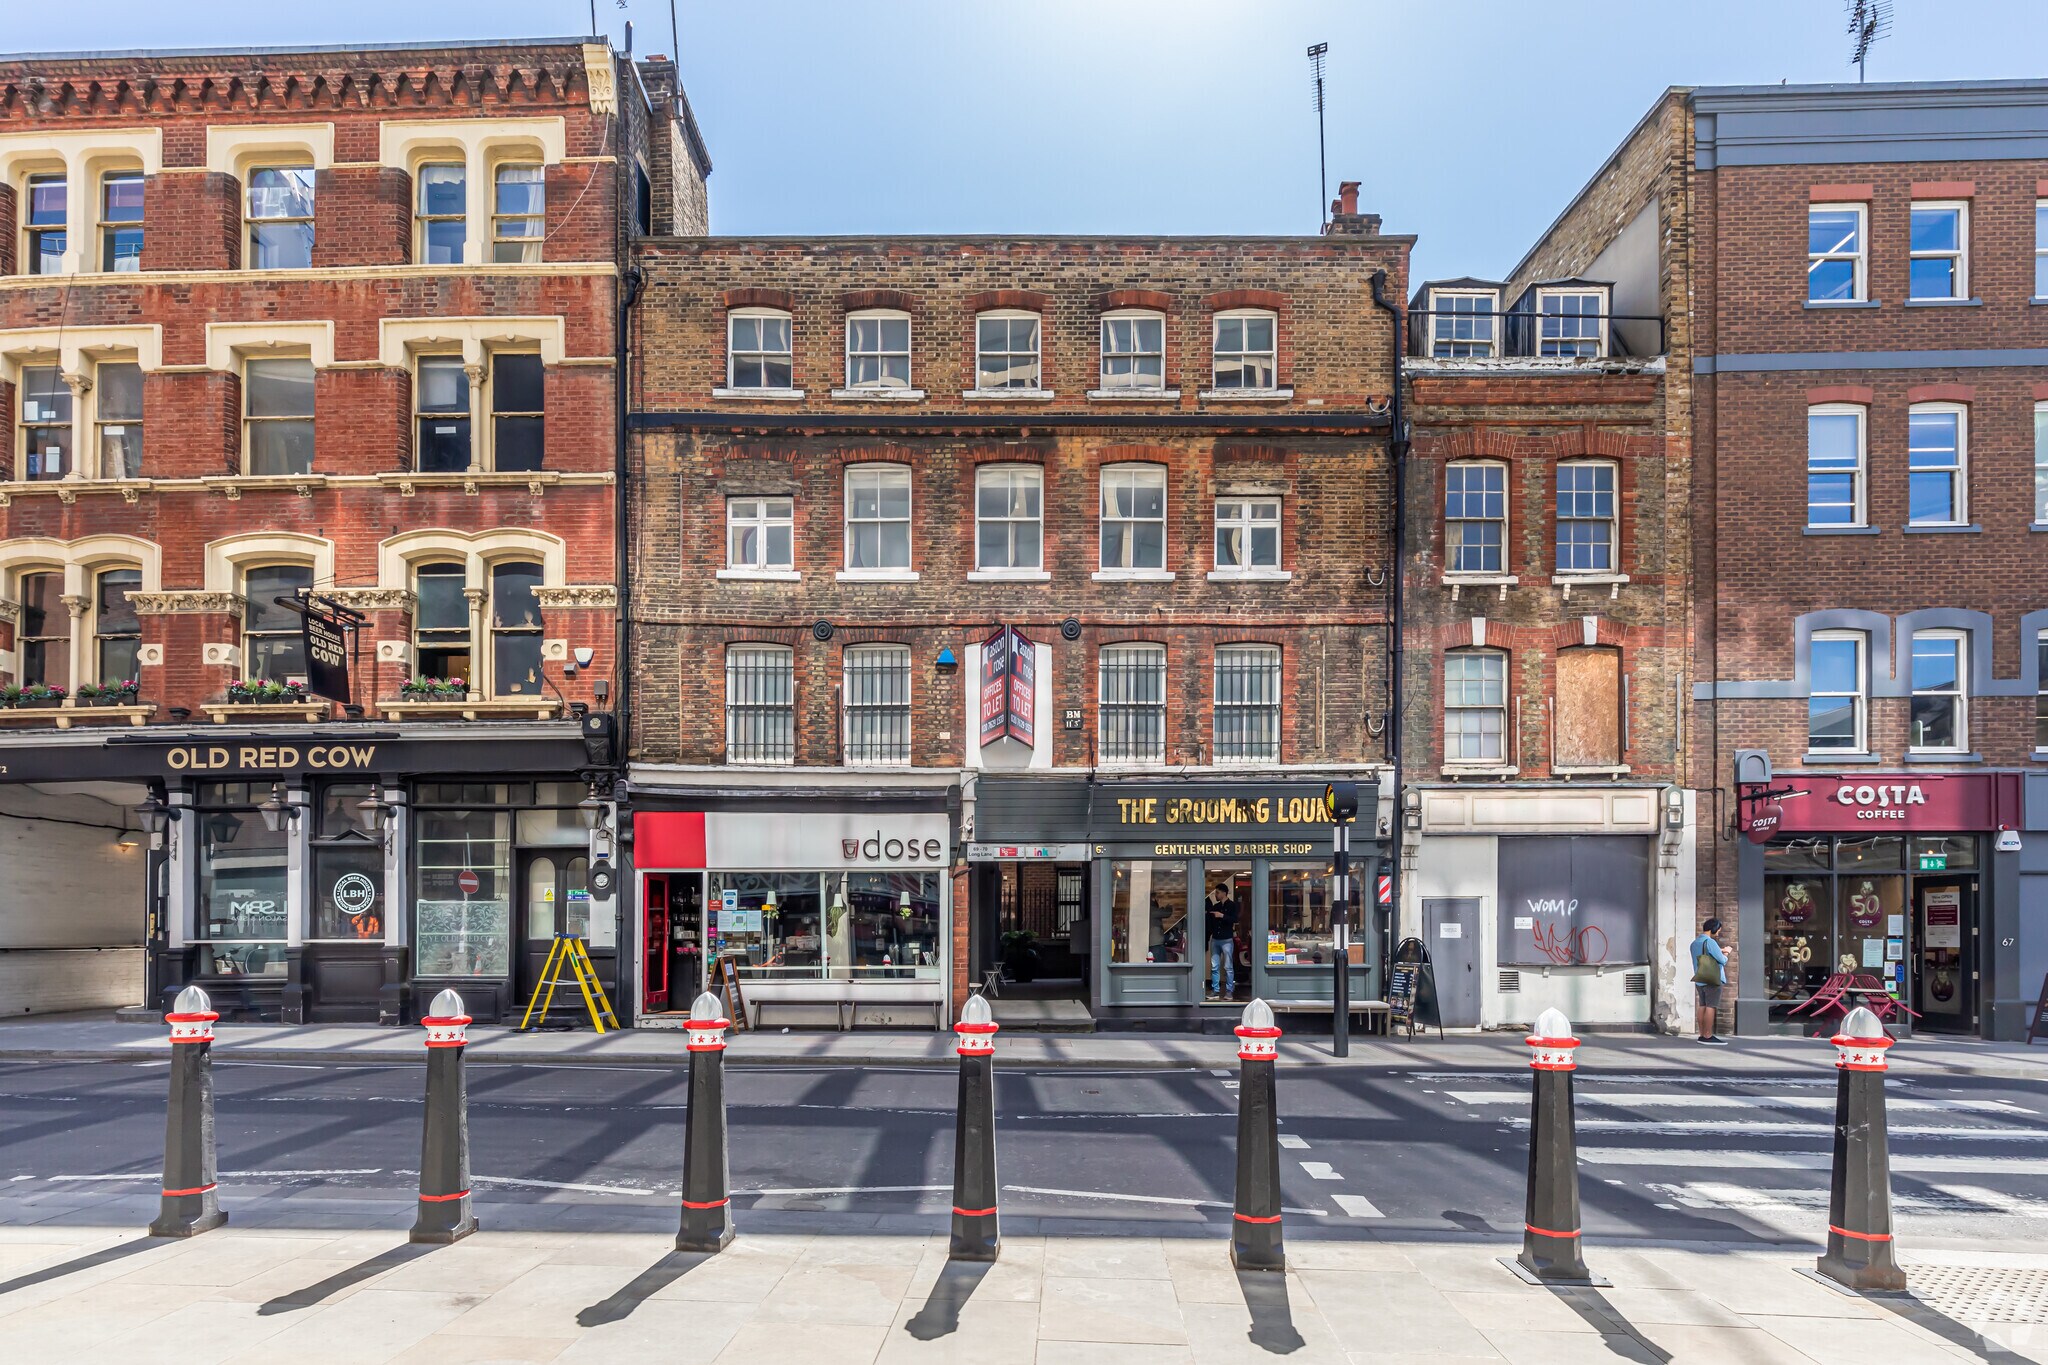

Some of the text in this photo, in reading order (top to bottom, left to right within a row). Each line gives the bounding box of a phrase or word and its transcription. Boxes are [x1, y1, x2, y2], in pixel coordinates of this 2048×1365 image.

[308, 618, 326, 629] LOCAL
[308, 625, 340, 641] BEER HOUSE
[310, 635, 344, 655] OLD RED
[311, 646, 340, 666] COW
[984, 679, 1002, 700] OFFICES
[1014, 679, 1030, 700] OFFICES
[984, 694, 1002, 718] TO LET
[1012, 695, 1032, 719] TO LET
[1066, 710, 1081, 718] BM
[167, 746, 376, 769] OLD RED COW
[0, 766, 7, 774] 2
[1836, 785, 1926, 808] COSTA
[1118, 798, 1356, 824] THE GROOMING LOUN
[1856, 810, 1905, 819] COFFEE
[1752, 816, 1777, 827] COSTA
[863, 830, 940, 858] dose
[1034, 848, 1048, 856] ink
[1155, 844, 1312, 855] GENTLEMEN'S BARBER SHOP
[1851, 894, 1880, 916] 50
[2002, 938, 2014, 946] 67
[1790, 946, 1812, 963] 50
